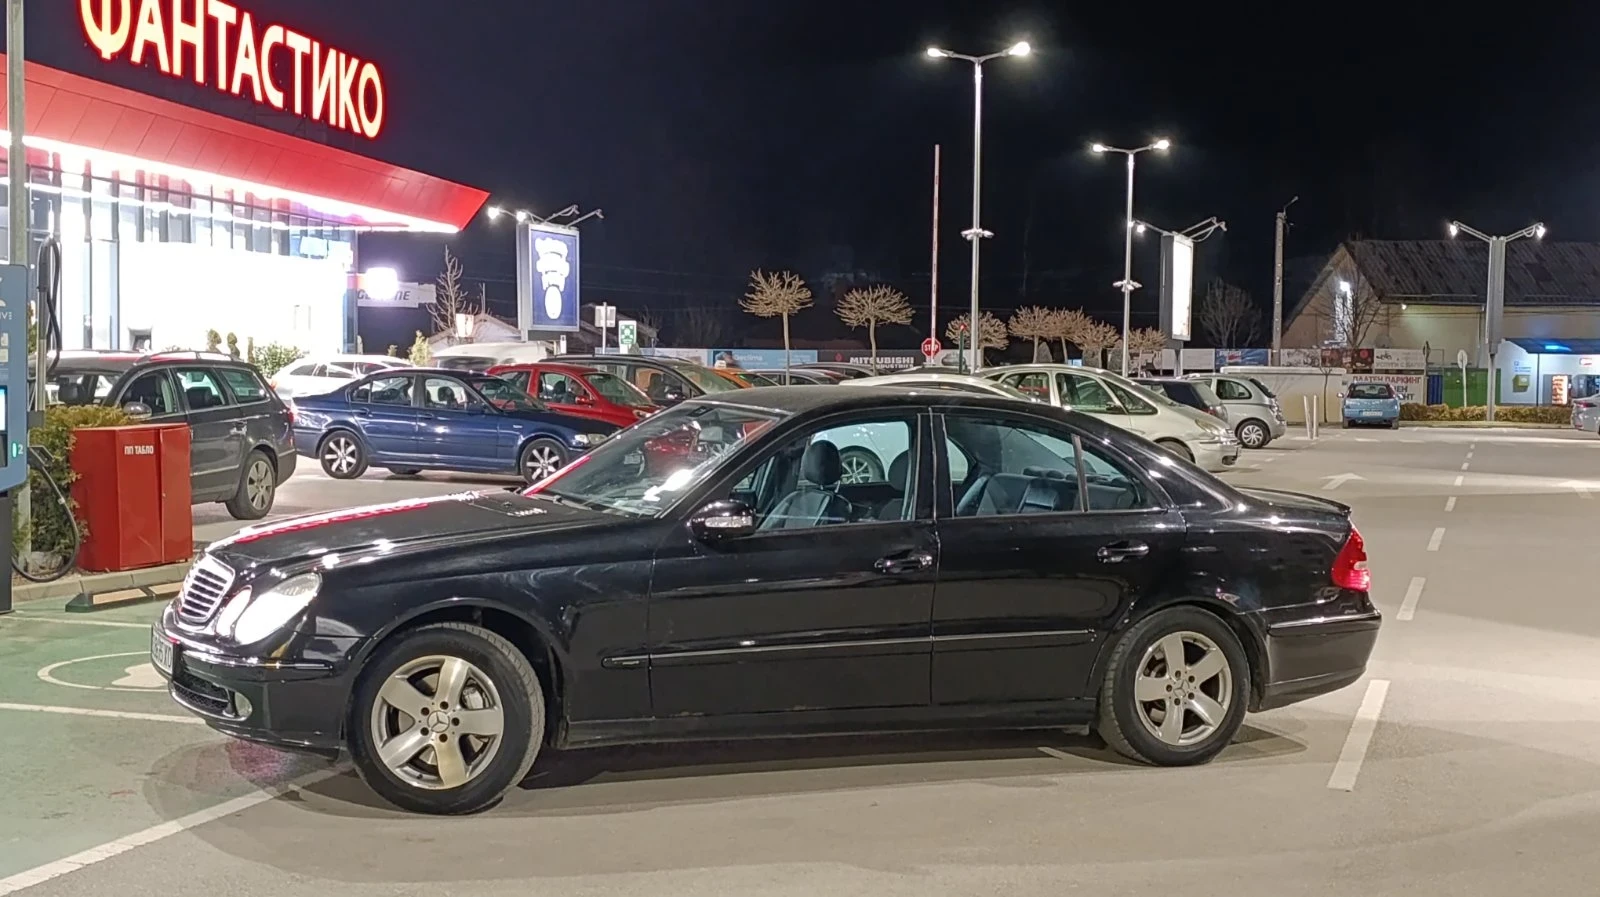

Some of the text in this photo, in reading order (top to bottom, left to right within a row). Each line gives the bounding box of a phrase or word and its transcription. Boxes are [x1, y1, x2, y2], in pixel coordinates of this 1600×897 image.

[80, 0, 384, 139] ФАНТАСТИКО
[924, 343, 939, 352] STP
[135, 445, 154, 455] ТАБЛО
